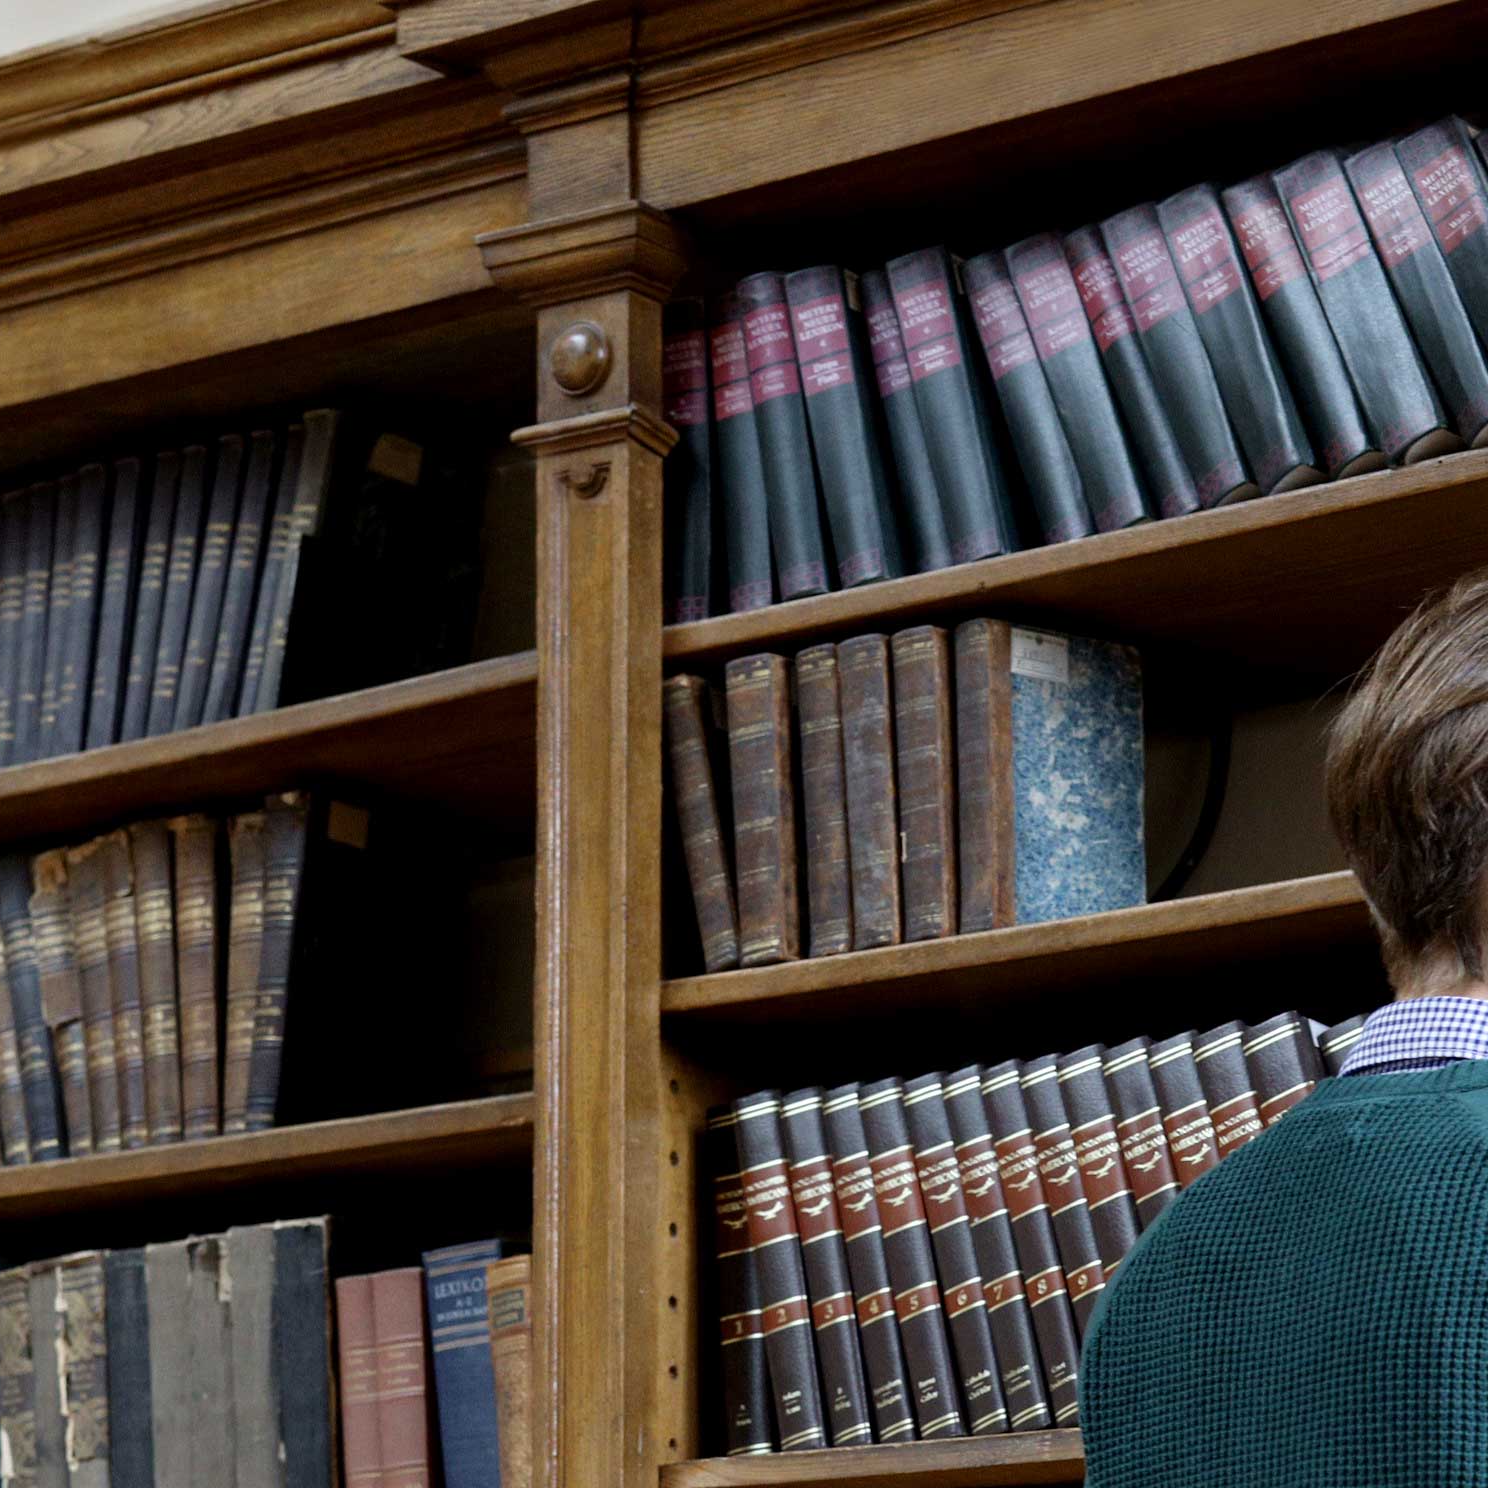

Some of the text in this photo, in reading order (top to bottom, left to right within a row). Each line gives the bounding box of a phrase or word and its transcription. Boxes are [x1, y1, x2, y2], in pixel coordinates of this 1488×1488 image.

[1420, 156, 1462, 188] MEYERS
[1428, 167, 1463, 194] NEUES
[1363, 173, 1406, 201] MEYERS
[1426, 173, 1470, 206] LEXIKON
[1369, 190, 1413, 219] LEXIKON
[1175, 218, 1216, 243] MEYERS
[1181, 235, 1224, 263] LEXIKON
[434, 1276, 489, 1300] LEXIKO
[1037, 1278, 1048, 1295] 8
[1078, 1273, 1089, 1290] 9
[957, 1291, 968, 1306] 6
[993, 1284, 1005, 1301] 7
[824, 1304, 834, 1319] 3
[868, 1301, 879, 1315] 4
[910, 1296, 919, 1311] 5
[776, 1308, 788, 1322] 2
[735, 1320, 744, 1334] 1
